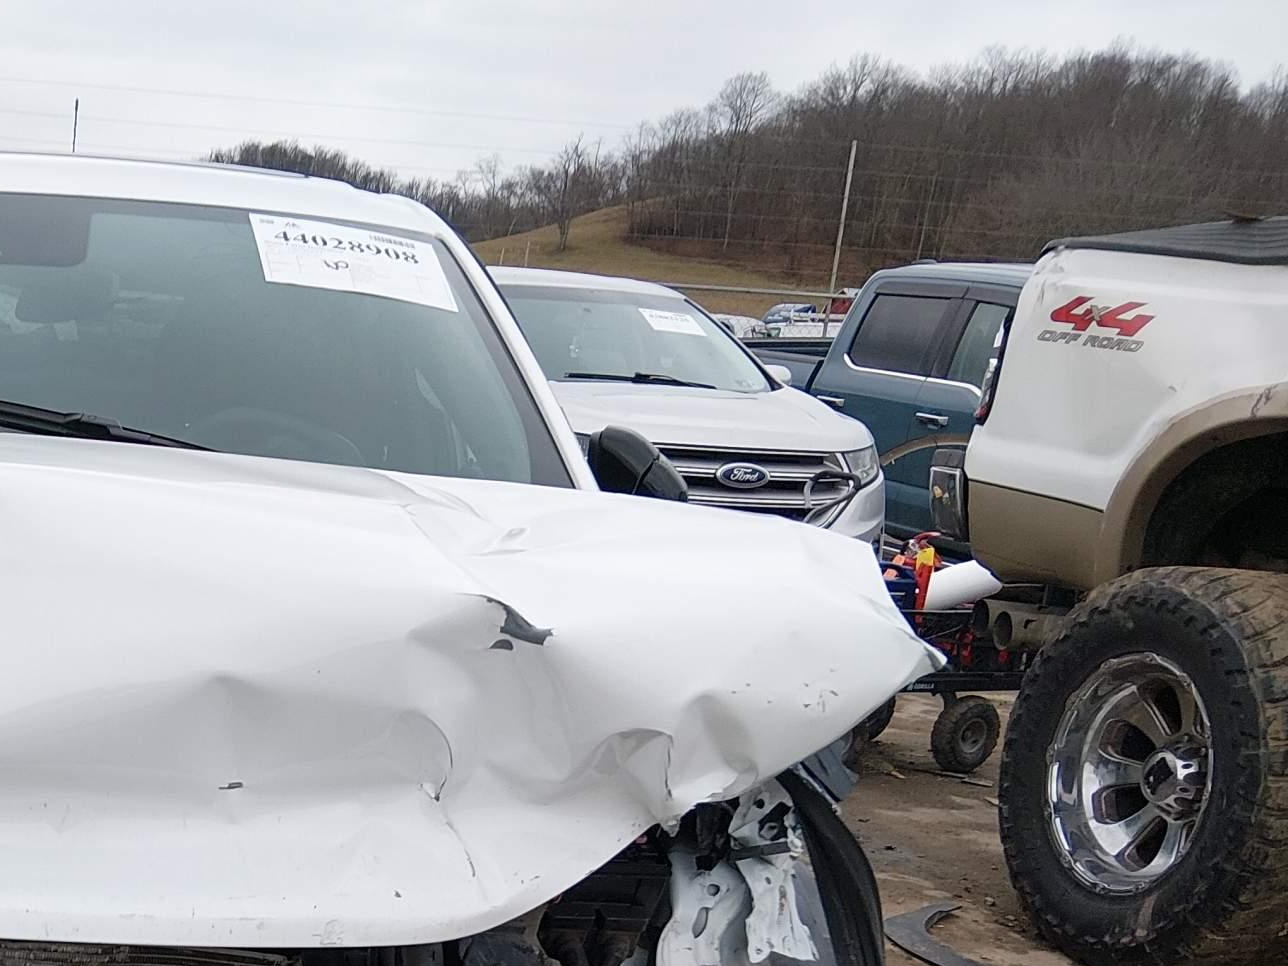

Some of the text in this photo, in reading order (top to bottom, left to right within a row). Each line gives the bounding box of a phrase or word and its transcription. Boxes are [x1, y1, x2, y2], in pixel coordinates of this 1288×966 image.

[274, 231, 420, 264] 44028908
[1037, 329, 1145, 353] OFF ROAD
[730, 467, 760, 481] Ford
